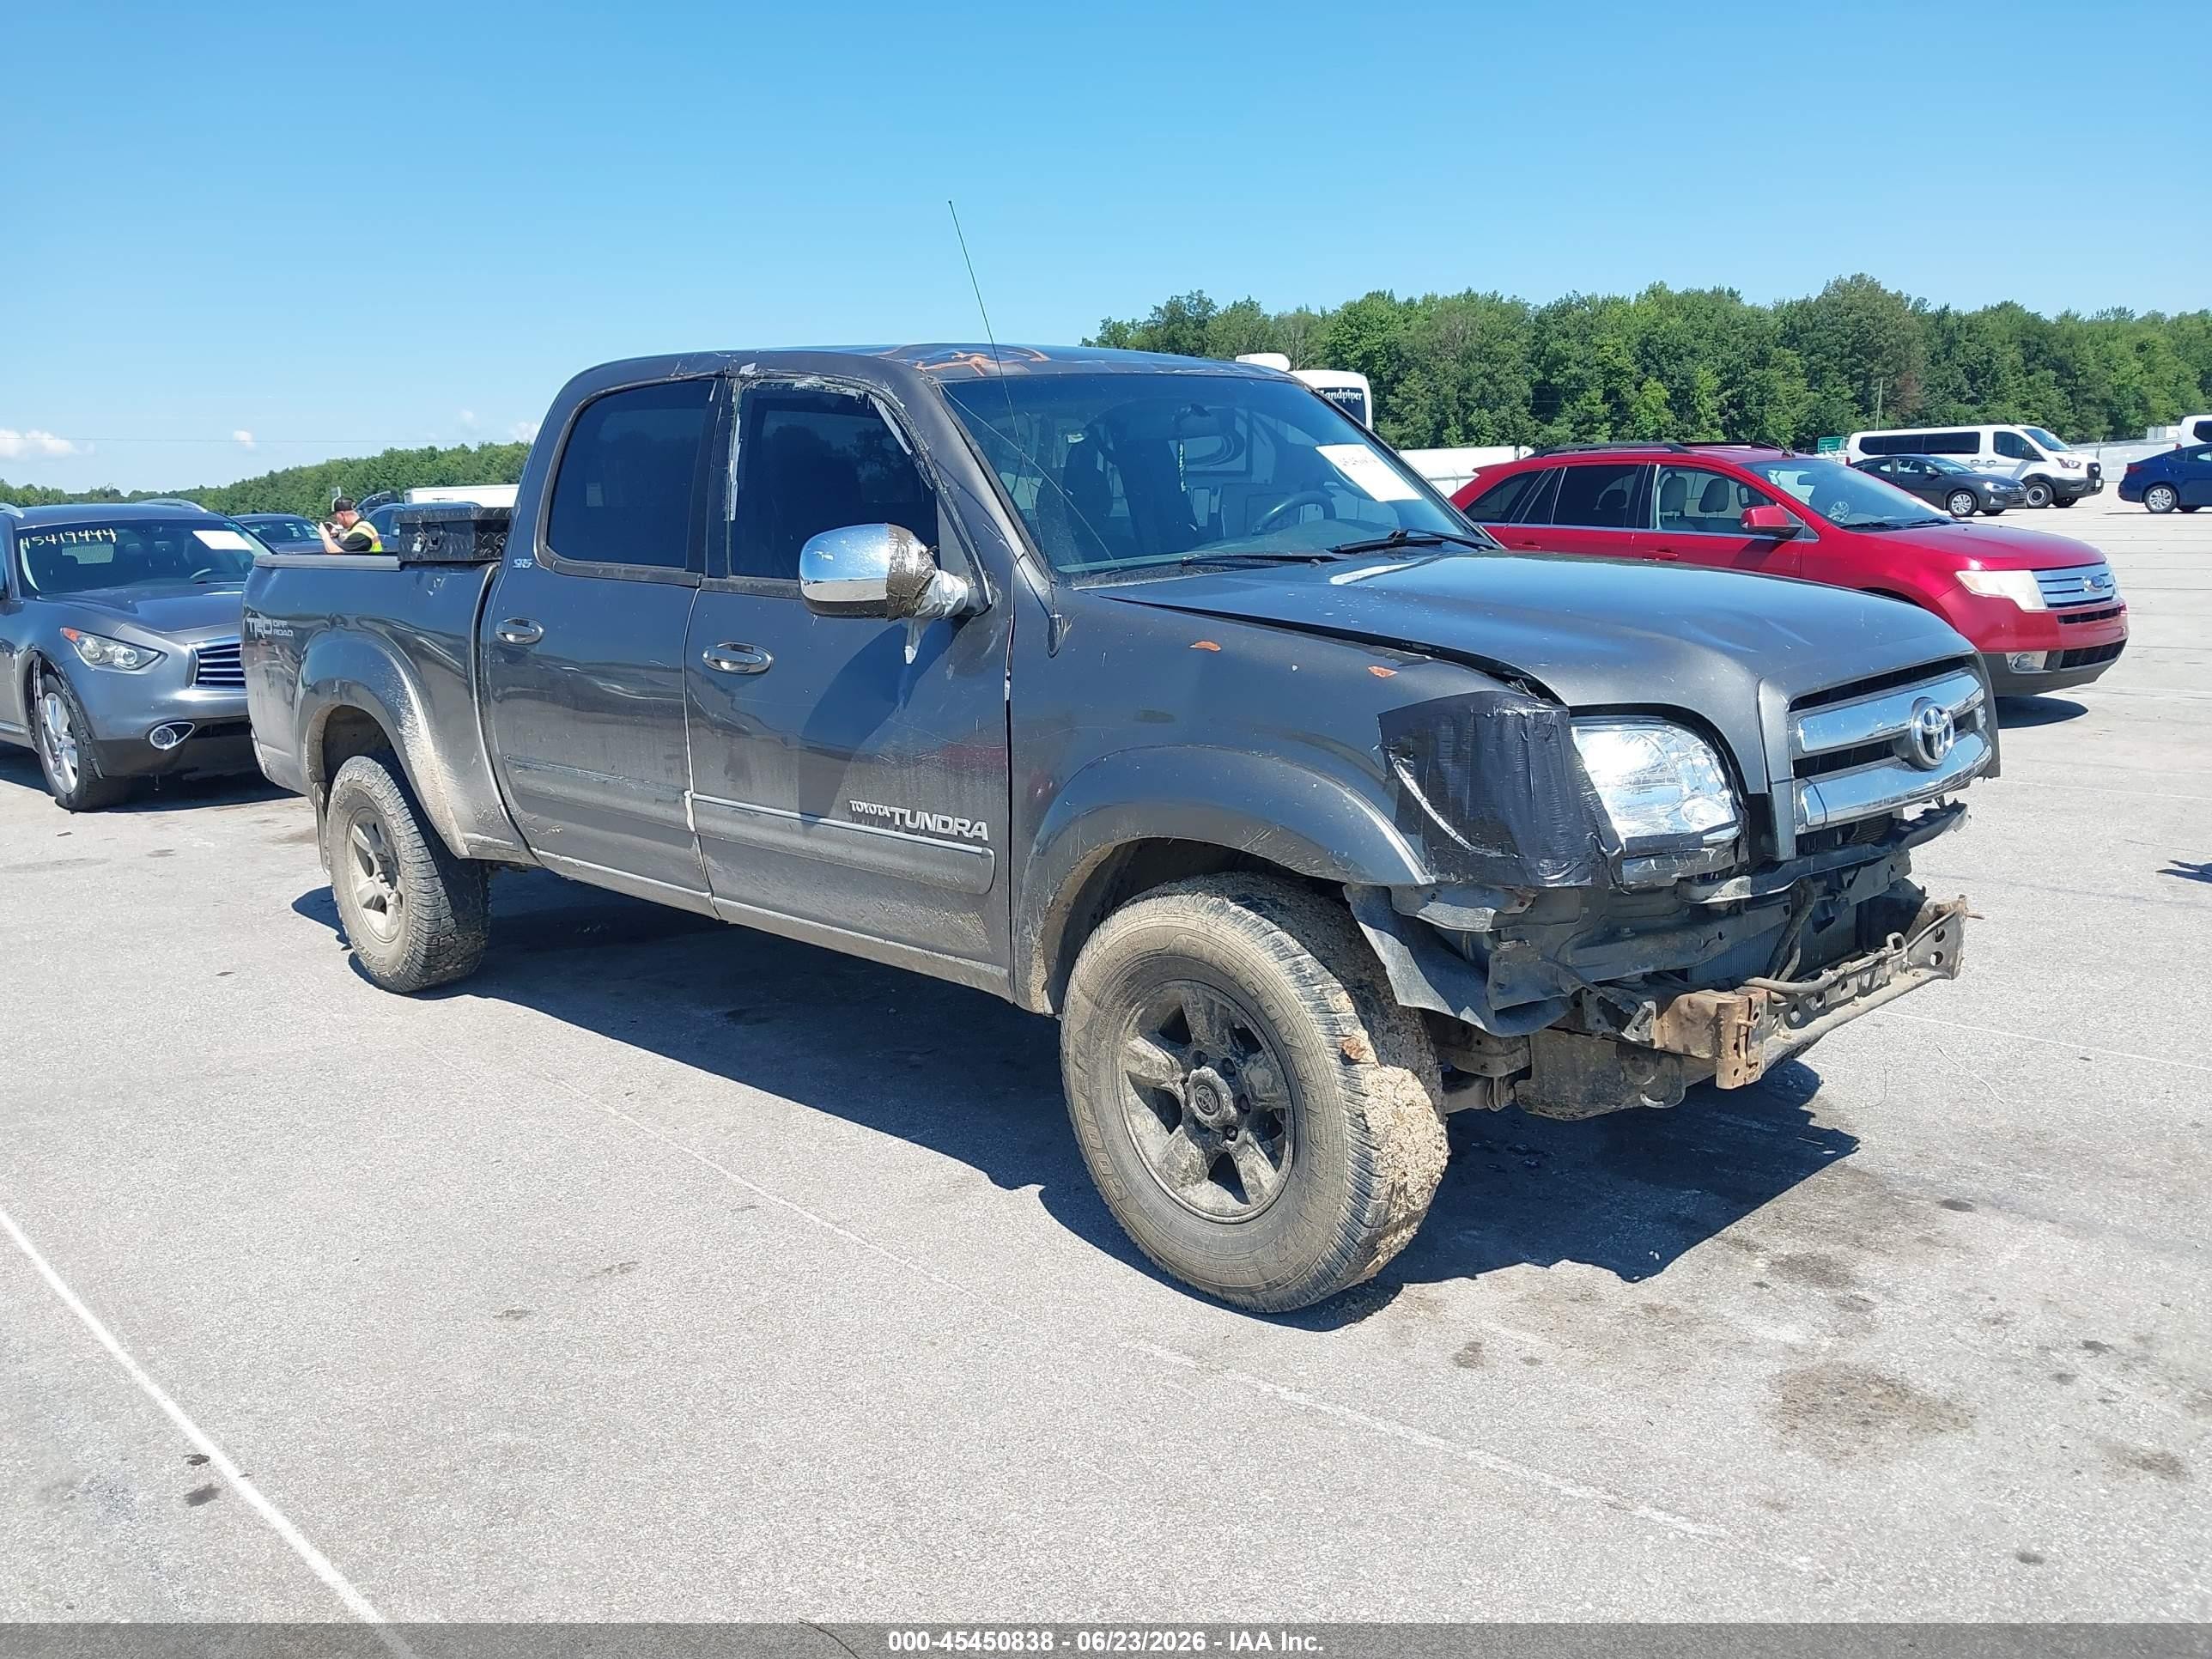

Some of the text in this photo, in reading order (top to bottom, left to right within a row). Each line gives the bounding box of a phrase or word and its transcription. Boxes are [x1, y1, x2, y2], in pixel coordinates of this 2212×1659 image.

[272, 619, 289, 628] OFF
[273, 629, 295, 637] ROAD
[849, 799, 989, 842] TOYOTA TUNDRA
